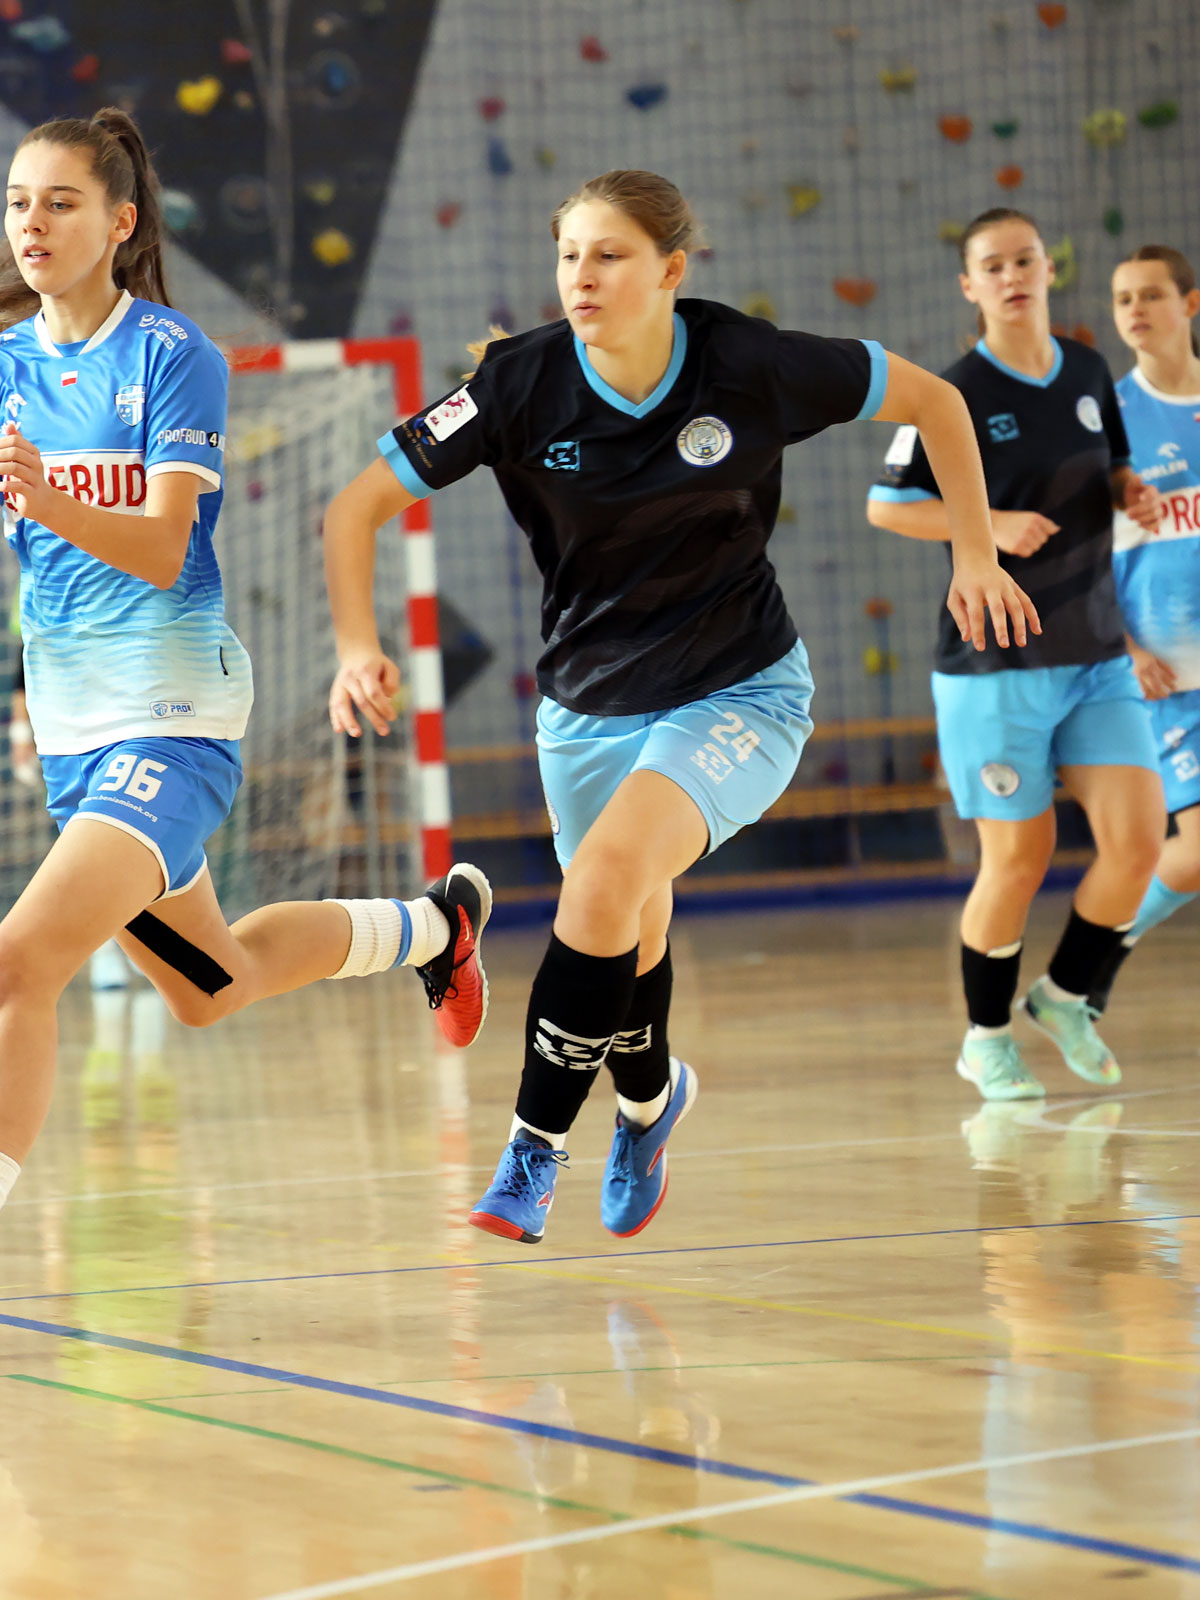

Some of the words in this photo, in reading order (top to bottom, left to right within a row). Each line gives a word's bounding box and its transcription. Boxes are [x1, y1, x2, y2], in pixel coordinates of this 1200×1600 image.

[154, 318, 188, 340] perga
[157, 427, 206, 446] PROFBUD
[708, 711, 761, 763] 24
[97, 754, 169, 803] 96
